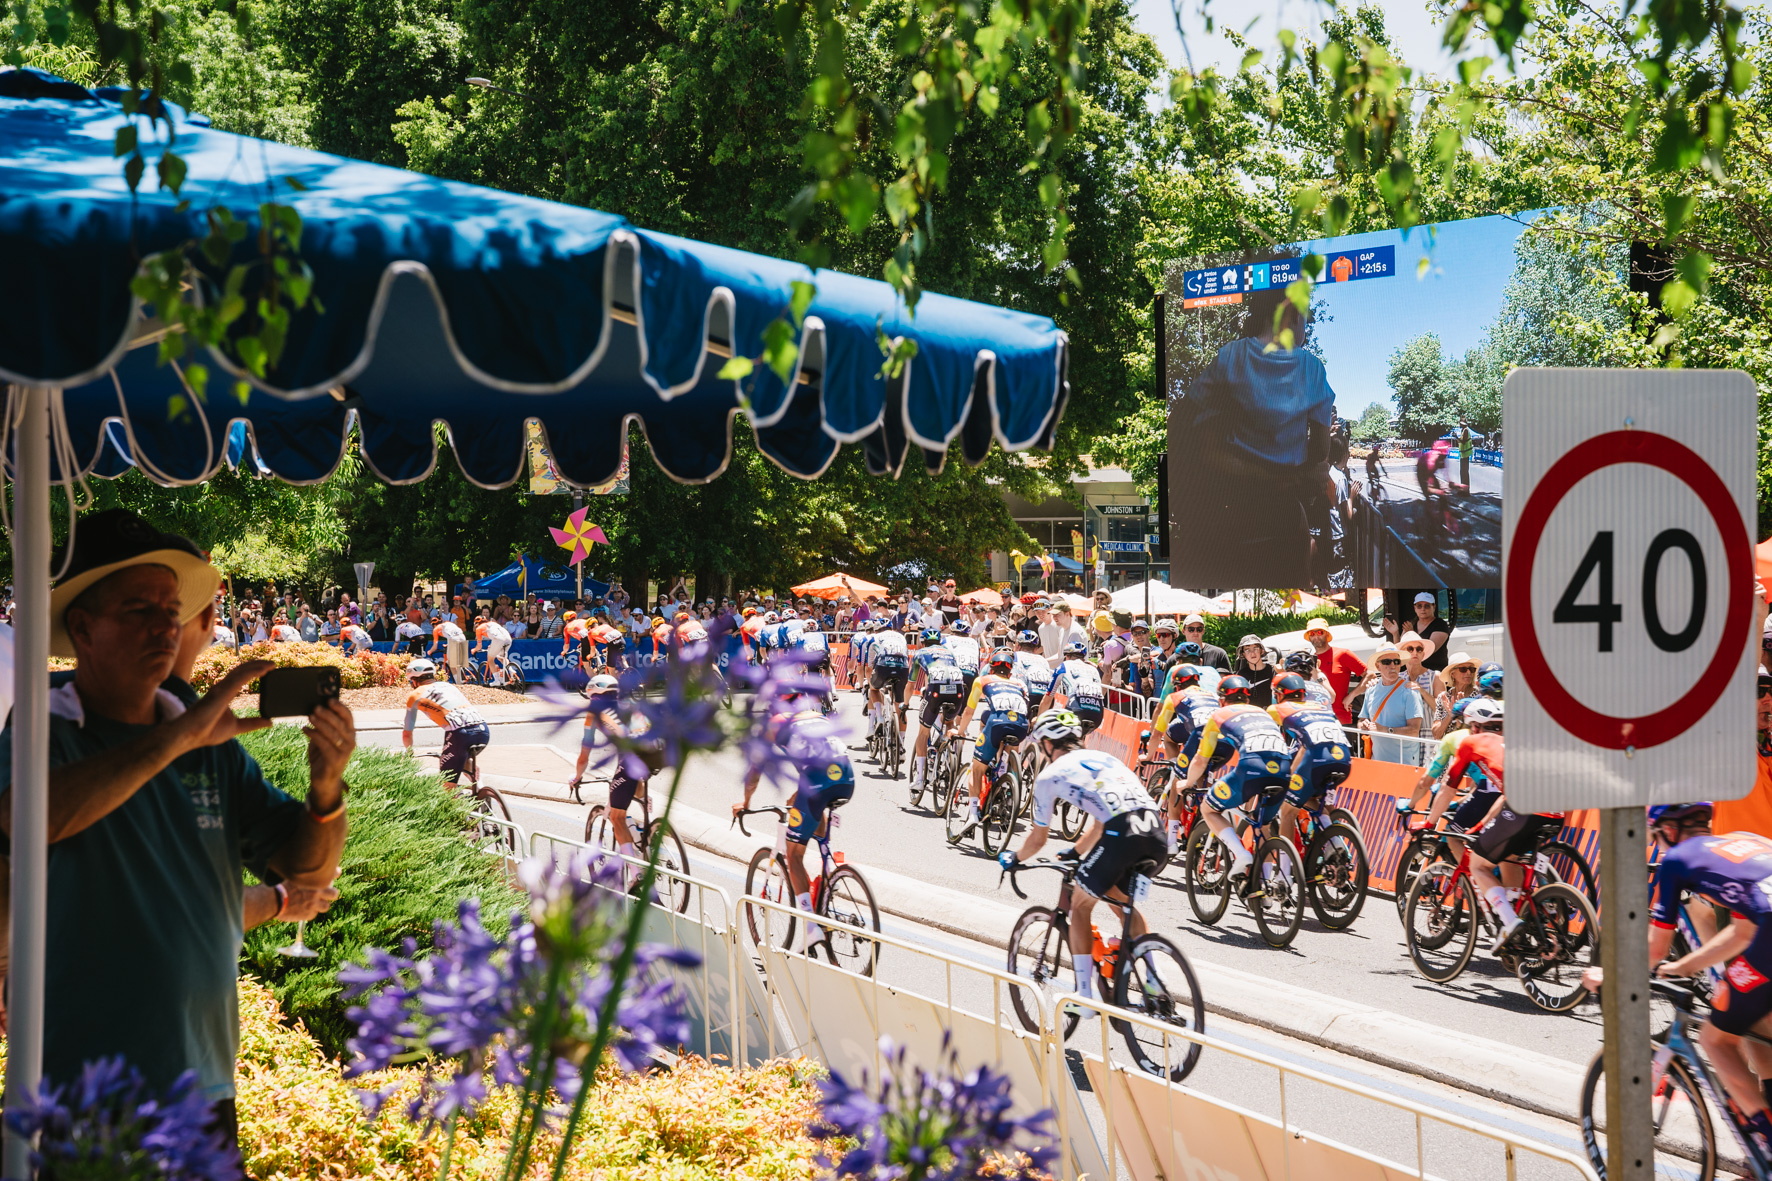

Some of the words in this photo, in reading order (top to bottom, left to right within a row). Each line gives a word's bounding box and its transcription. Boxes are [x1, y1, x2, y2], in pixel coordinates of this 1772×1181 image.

[1360, 253, 1375, 261] GAP
[1360, 262, 1381, 274] +2:15
[1258, 269, 1264, 282] 1
[1272, 273, 1288, 284] 61.9
[1104, 506, 1133, 514] JOHNSTON
[1103, 543, 1124, 551] MEDICAL
[1126, 543, 1142, 551] CLINIC
[1552, 528, 1708, 653] 40
[508, 652, 578, 670] Santos
[1080, 697, 1100, 707] BORA
